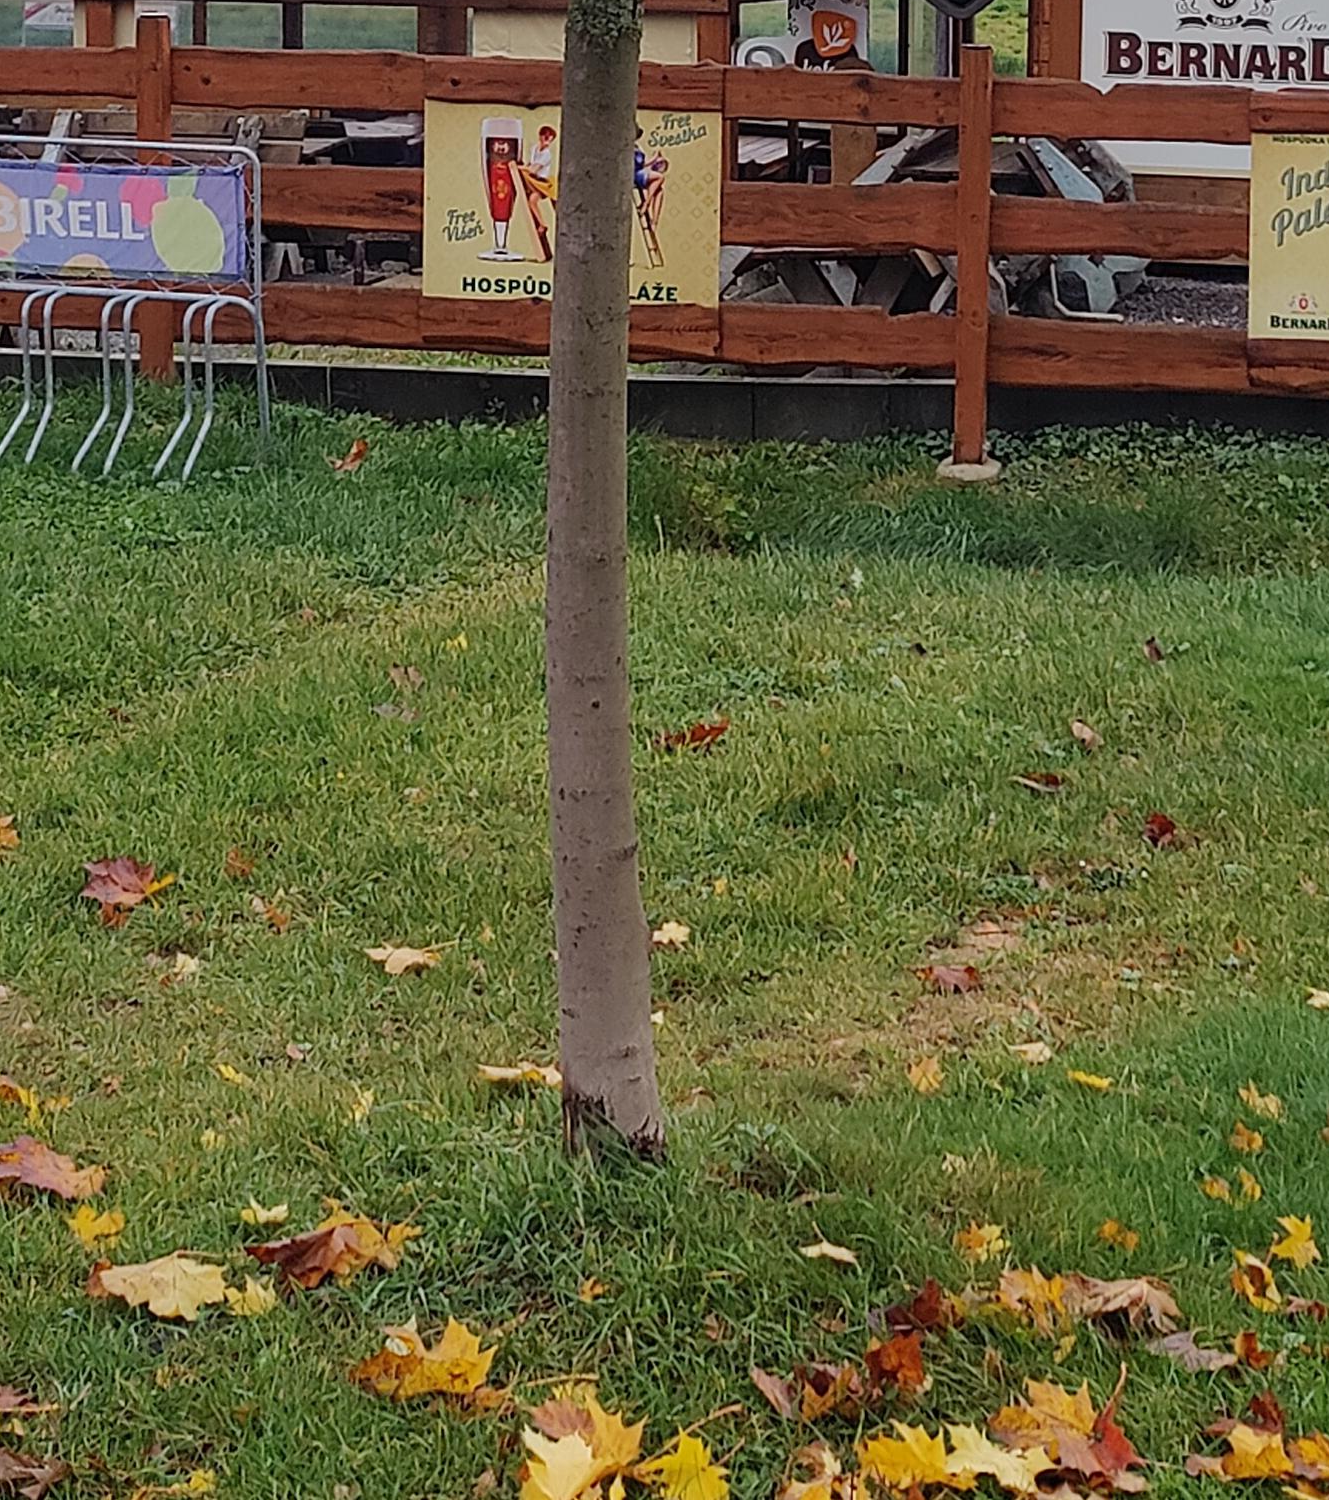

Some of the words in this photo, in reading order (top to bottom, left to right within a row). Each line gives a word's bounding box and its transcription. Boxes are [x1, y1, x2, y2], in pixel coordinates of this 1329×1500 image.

[1281, 10, 1328, 33] Pivo
[661, 113, 692, 130] Free
[446, 208, 476, 226] Free
[461, 274, 552, 296] HOSPŮD
[628, 280, 678, 302] ÁŽE
